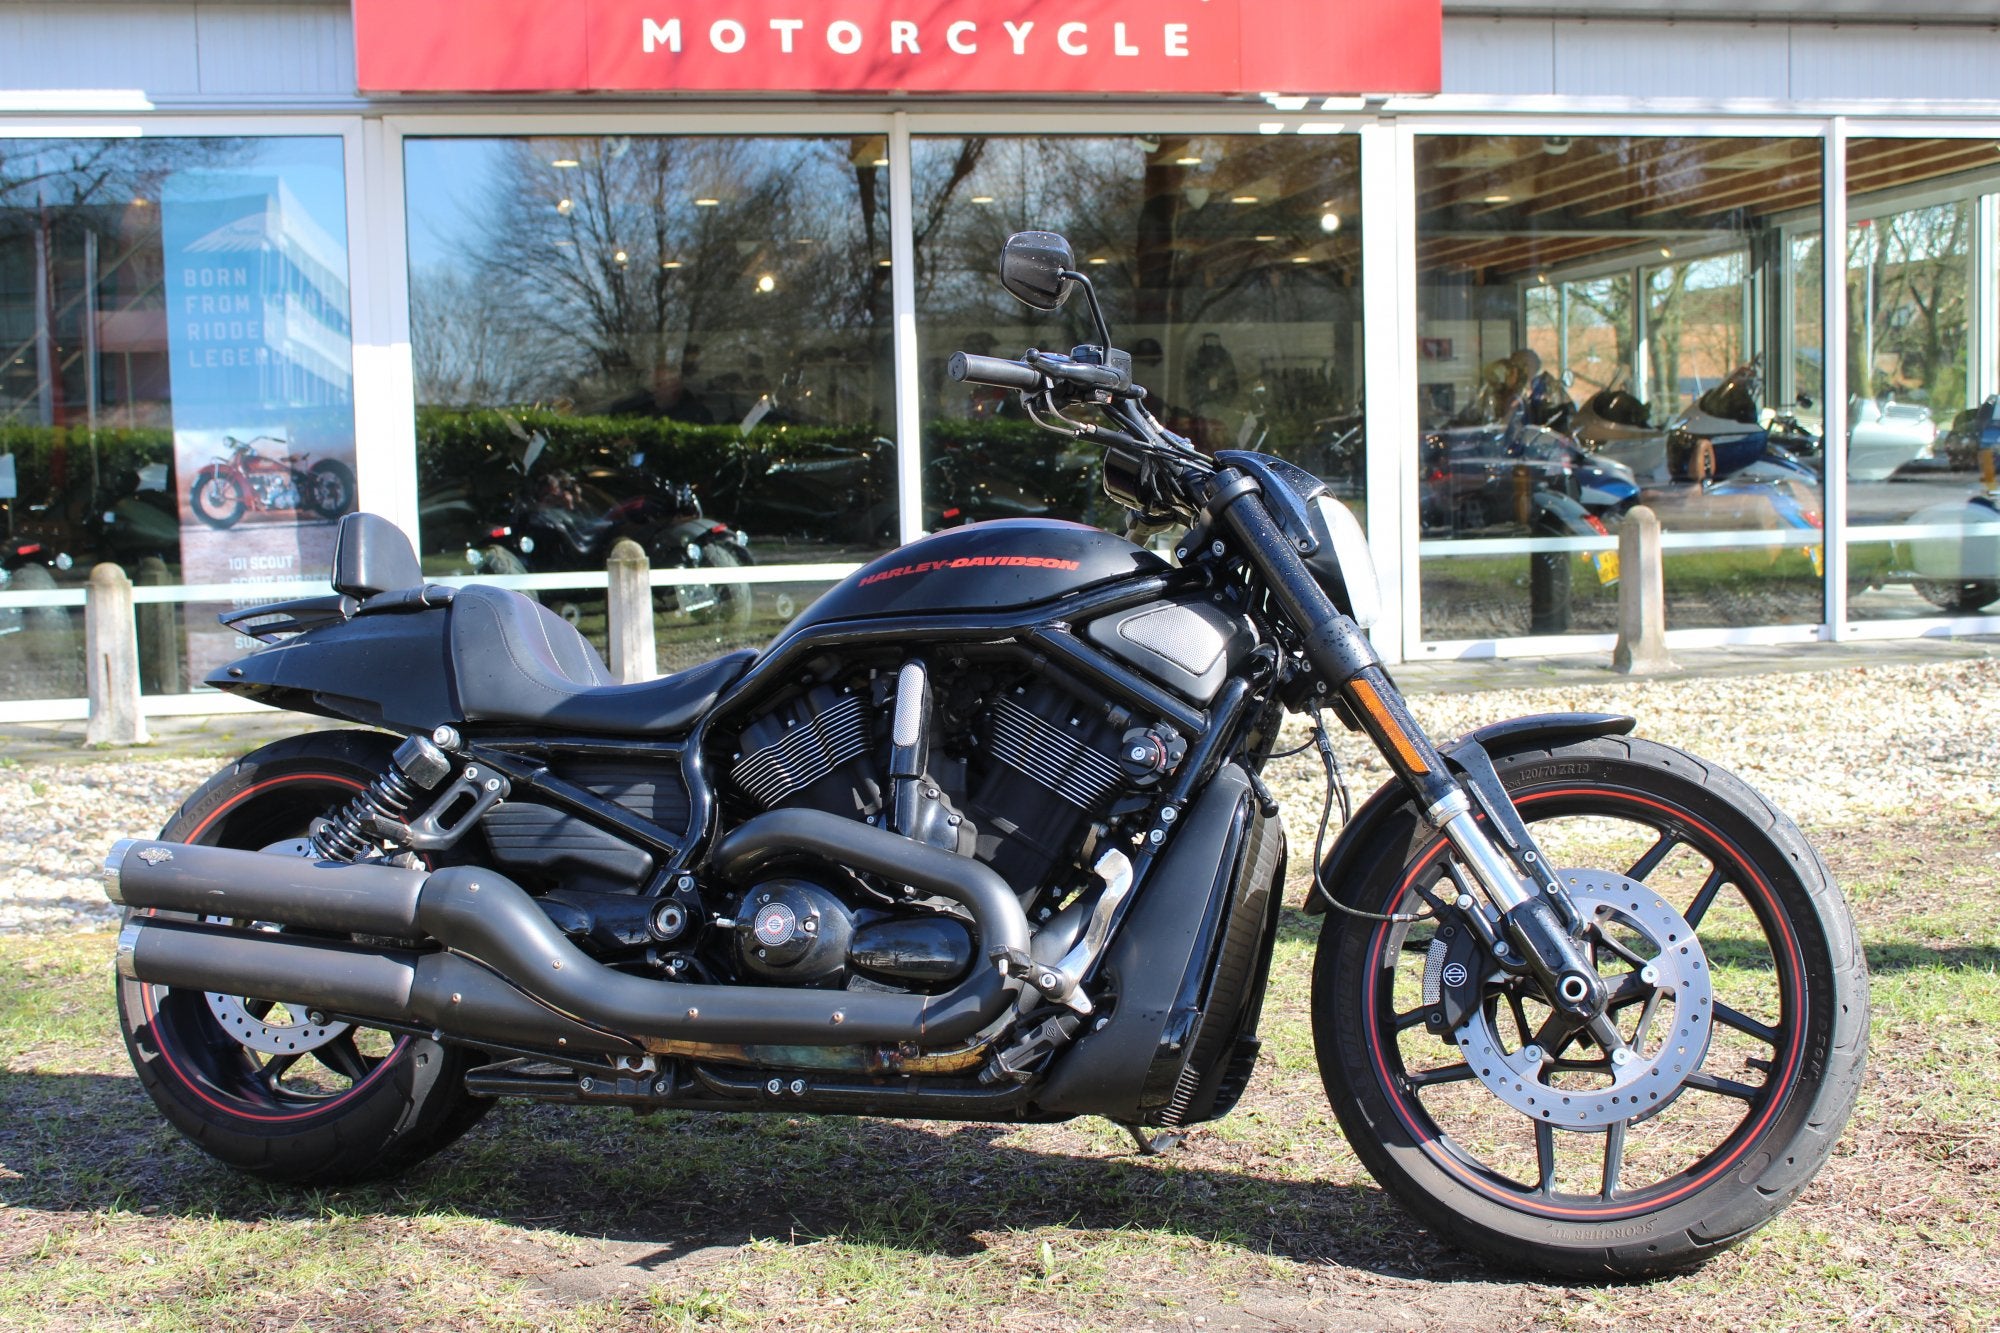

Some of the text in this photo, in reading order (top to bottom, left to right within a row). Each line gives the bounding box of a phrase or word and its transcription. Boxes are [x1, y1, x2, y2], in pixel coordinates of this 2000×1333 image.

[642, 18, 1189, 57] MOTORCYCLE
[184, 267, 247, 288] BORN
[185, 294, 250, 315] FROM
[249, 555, 294, 570] SCOUT
[858, 556, 1081, 587] HARLEY-DAVIDSON
[1520, 766, 1557, 781] 120/70
[1574, 1217, 1658, 1241] SCORCHER
